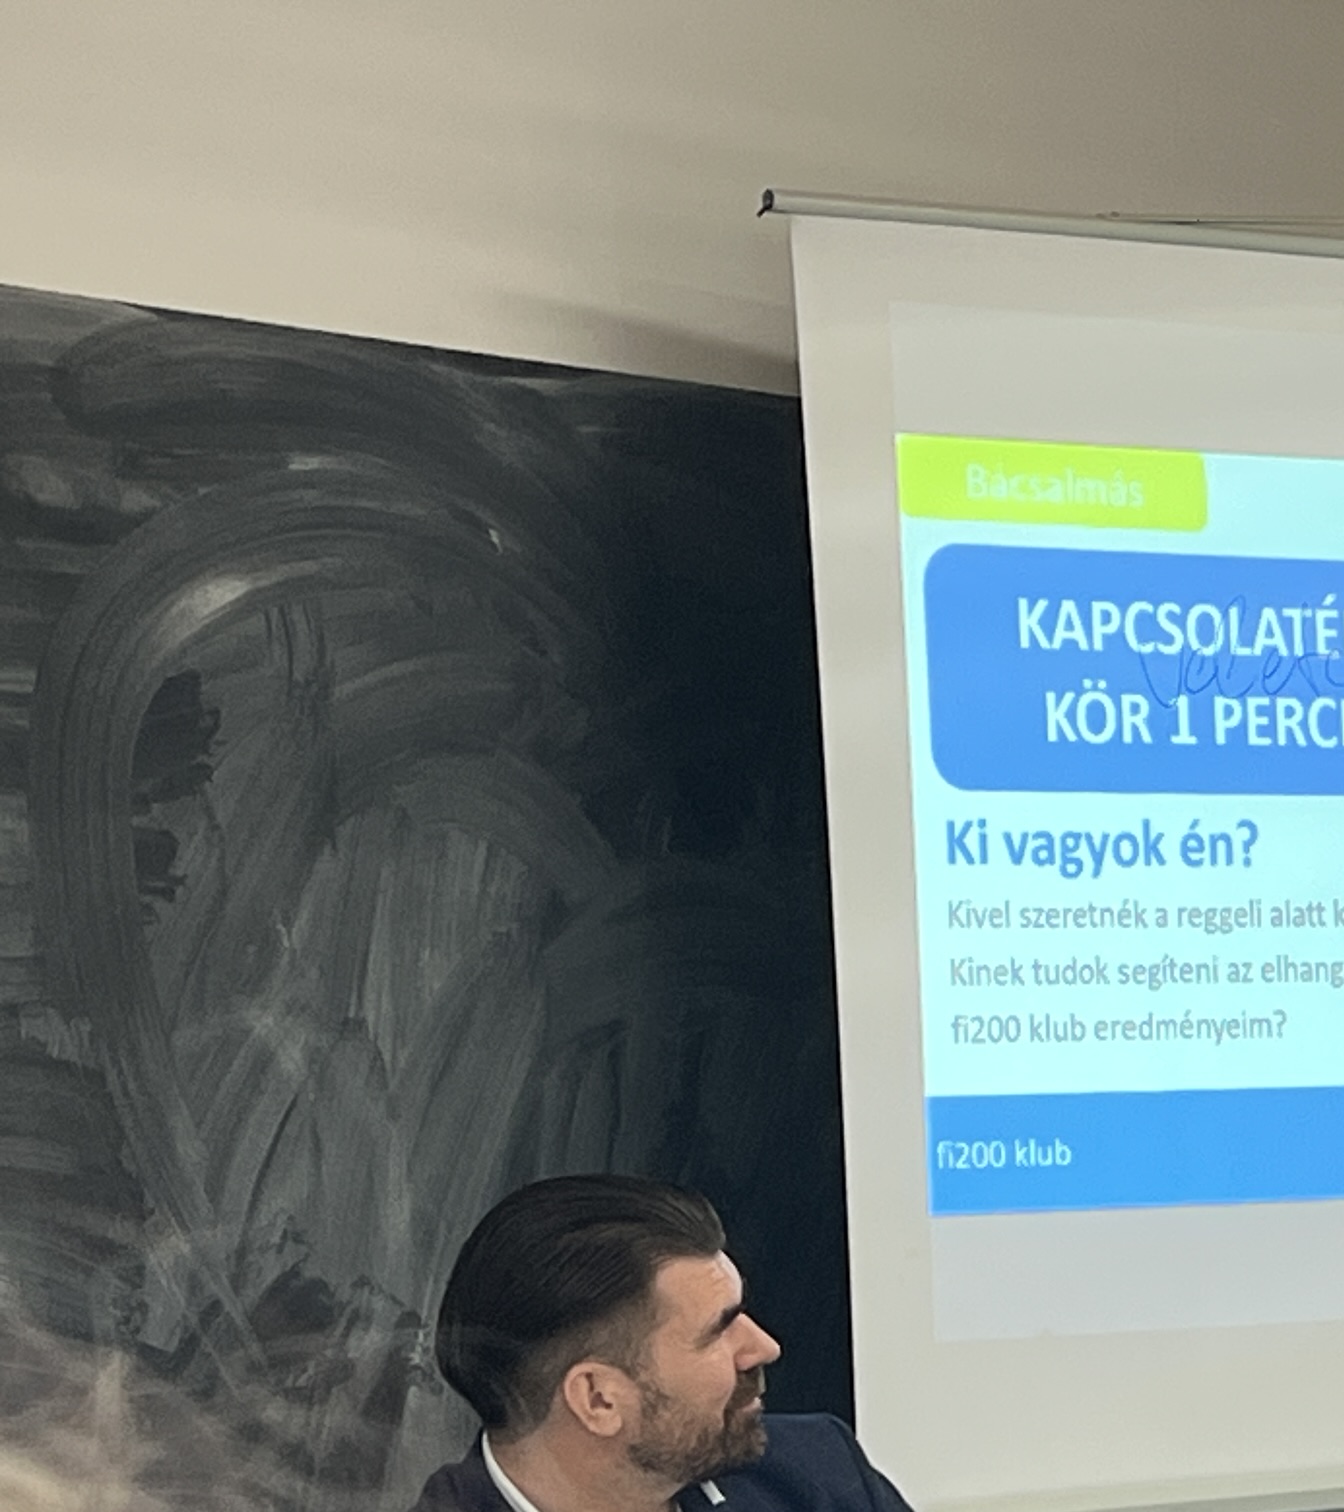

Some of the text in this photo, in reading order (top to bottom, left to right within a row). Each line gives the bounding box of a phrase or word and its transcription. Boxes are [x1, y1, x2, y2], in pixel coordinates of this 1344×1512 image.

[965, 463, 1146, 508] Bácsalmás
[1045, 679, 1152, 746] KÖR
[1170, 696, 1197, 746] 1
[946, 818, 1259, 879] Ki vagyok én?
[948, 899, 1010, 929] Kivel
[1019, 898, 1149, 929] szeretnék
[1154, 905, 1169, 929] a
[1176, 898, 1262, 934] reggeli
[1269, 898, 1327, 928] alatt
[950, 956, 1025, 987] Kinek
[1032, 955, 1110, 986] tudok
[1117, 953, 1219, 991] segíteni
[1226, 961, 1253, 985] az
[951, 1009, 1288, 1046] fi200 klub eredményeim?
[936, 1137, 1072, 1170] fi200 klub
